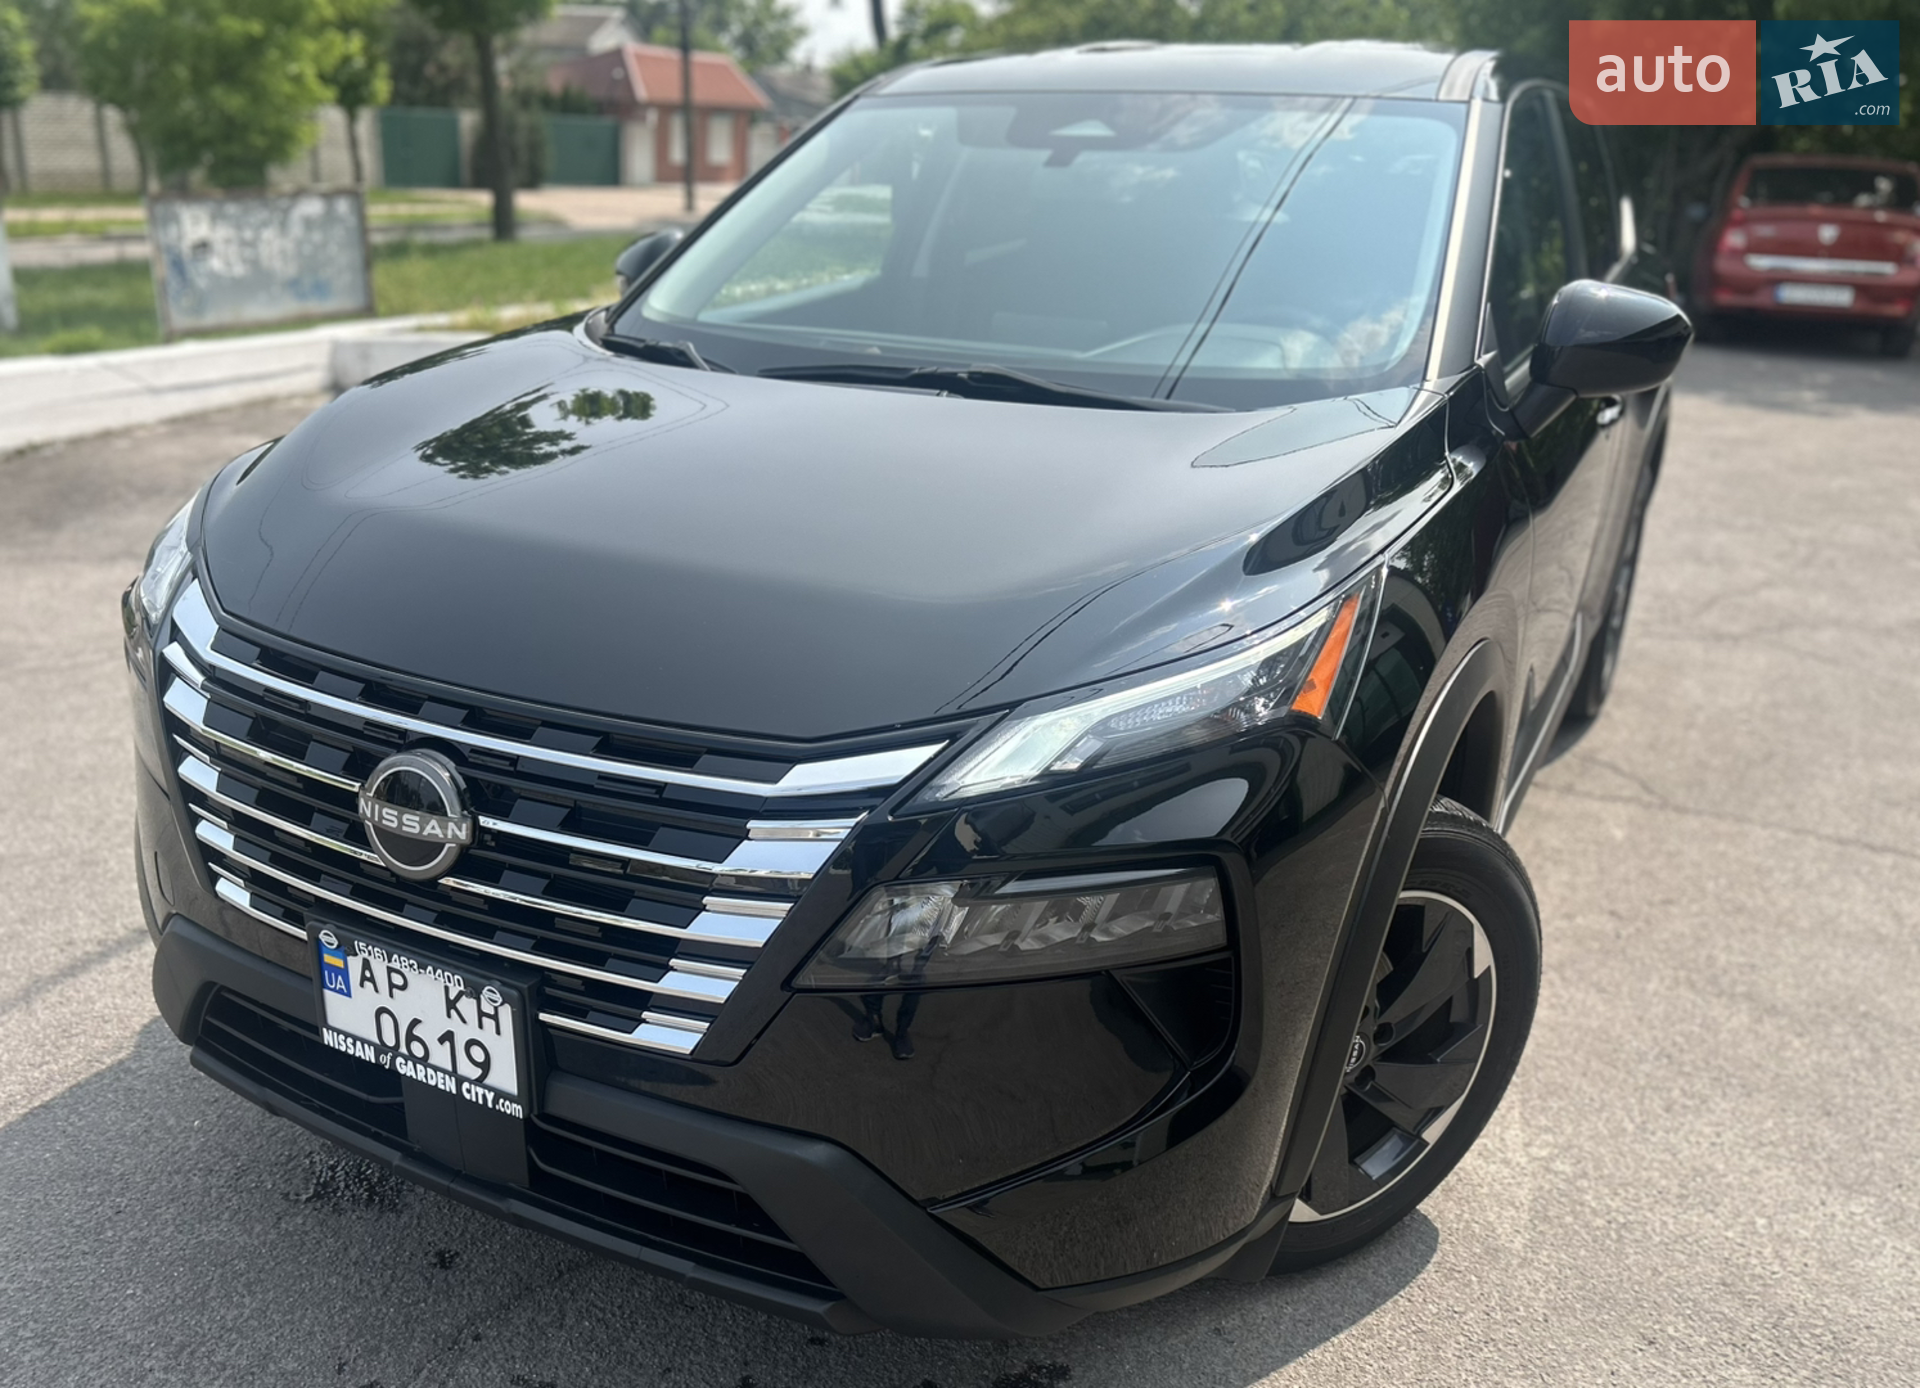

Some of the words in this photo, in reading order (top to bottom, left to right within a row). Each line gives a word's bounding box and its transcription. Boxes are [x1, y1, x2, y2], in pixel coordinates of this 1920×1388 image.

[360, 797, 467, 840] NISSAN
[325, 973, 347, 993] UA
[354, 940, 388, 963] (516)
[388, 954, 465, 990] 483-4400
[359, 957, 408, 998] AP
[444, 984, 501, 1036] KH
[322, 1028, 376, 1063] NISSAN
[379, 1052, 393, 1069] of
[395, 1056, 457, 1094] GARDEN
[374, 1005, 491, 1083] 0619
